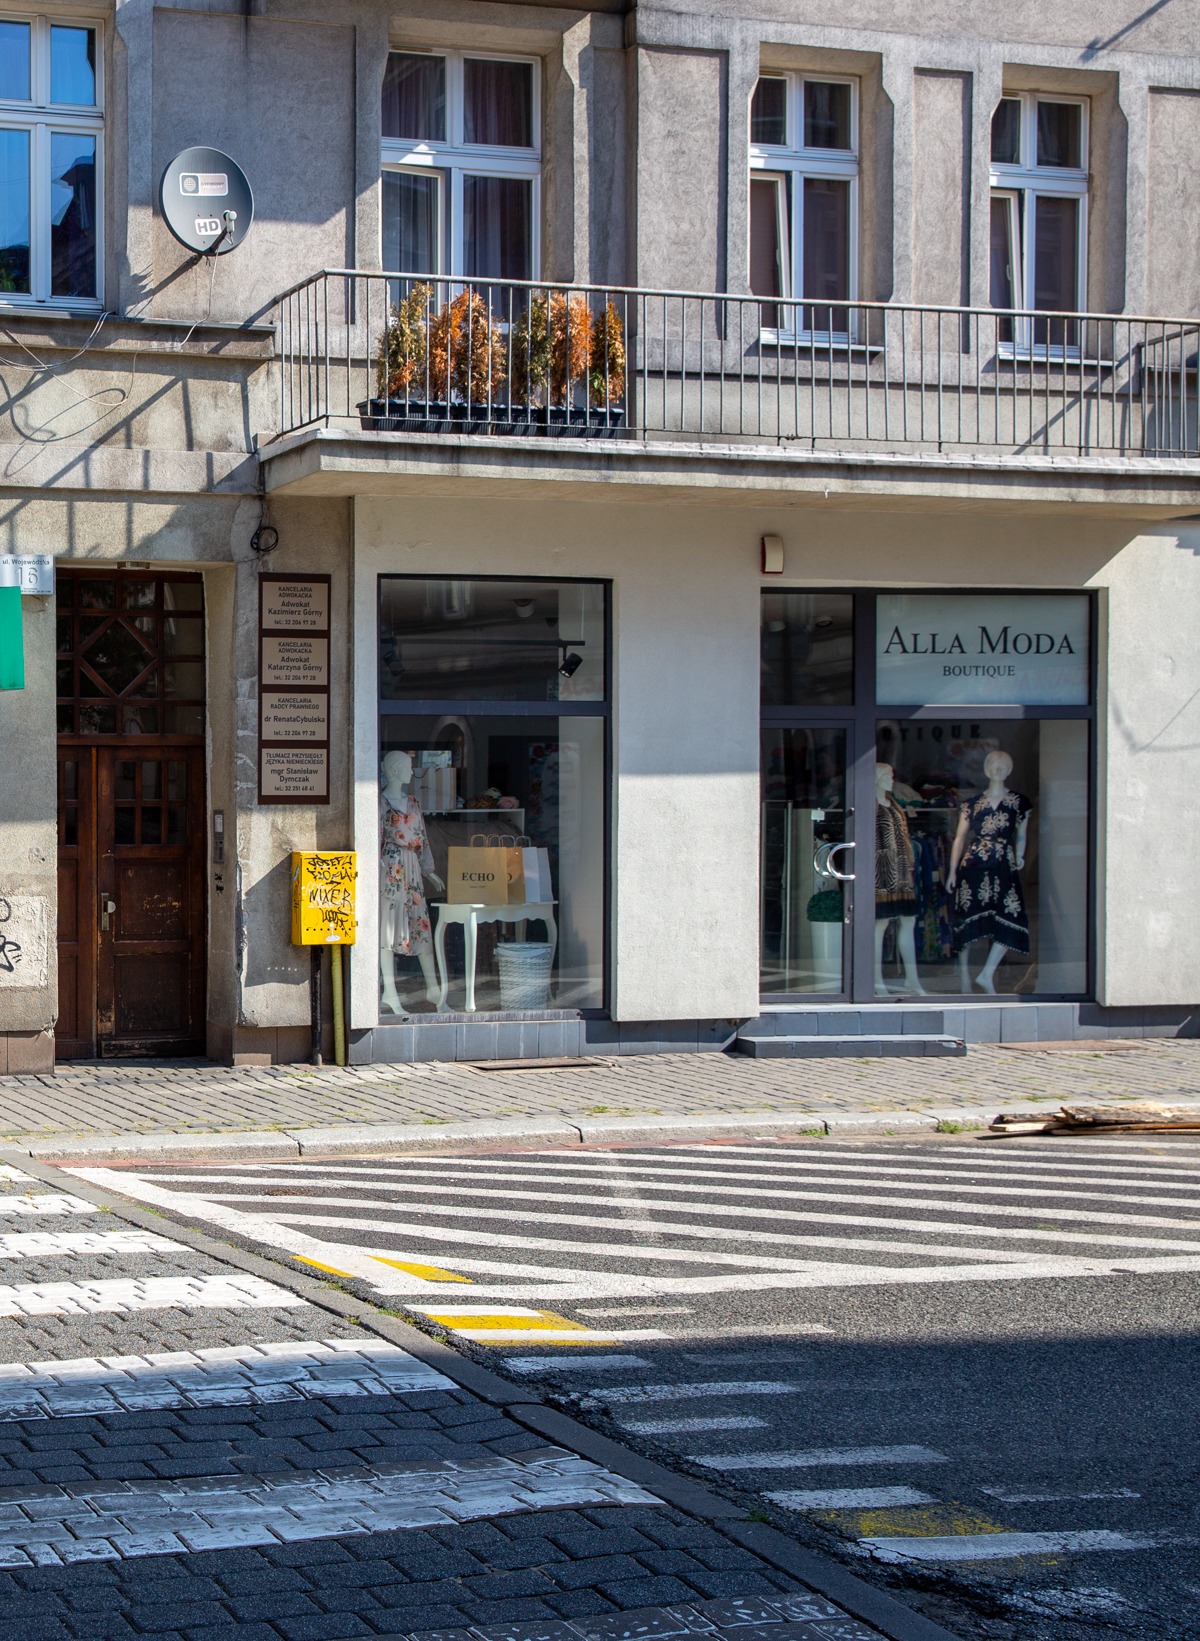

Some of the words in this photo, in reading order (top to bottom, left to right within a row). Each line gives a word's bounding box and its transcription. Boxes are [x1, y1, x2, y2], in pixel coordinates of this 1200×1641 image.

[197, 220, 219, 233] HD
[15, 567, 39, 586] 16
[268, 608, 301, 616] Kazimierz
[303, 608, 323, 618] Górny
[882, 625, 968, 655] ALLA
[976, 625, 1077, 655] MODA
[267, 663, 301, 672] Katarzyna
[302, 664, 323, 673] Górny
[942, 665, 1016, 678] BOUTIQUE
[286, 767, 319, 775] Stanisław
[279, 775, 310, 784] Dymczak
[461, 872, 495, 882] ECHO
